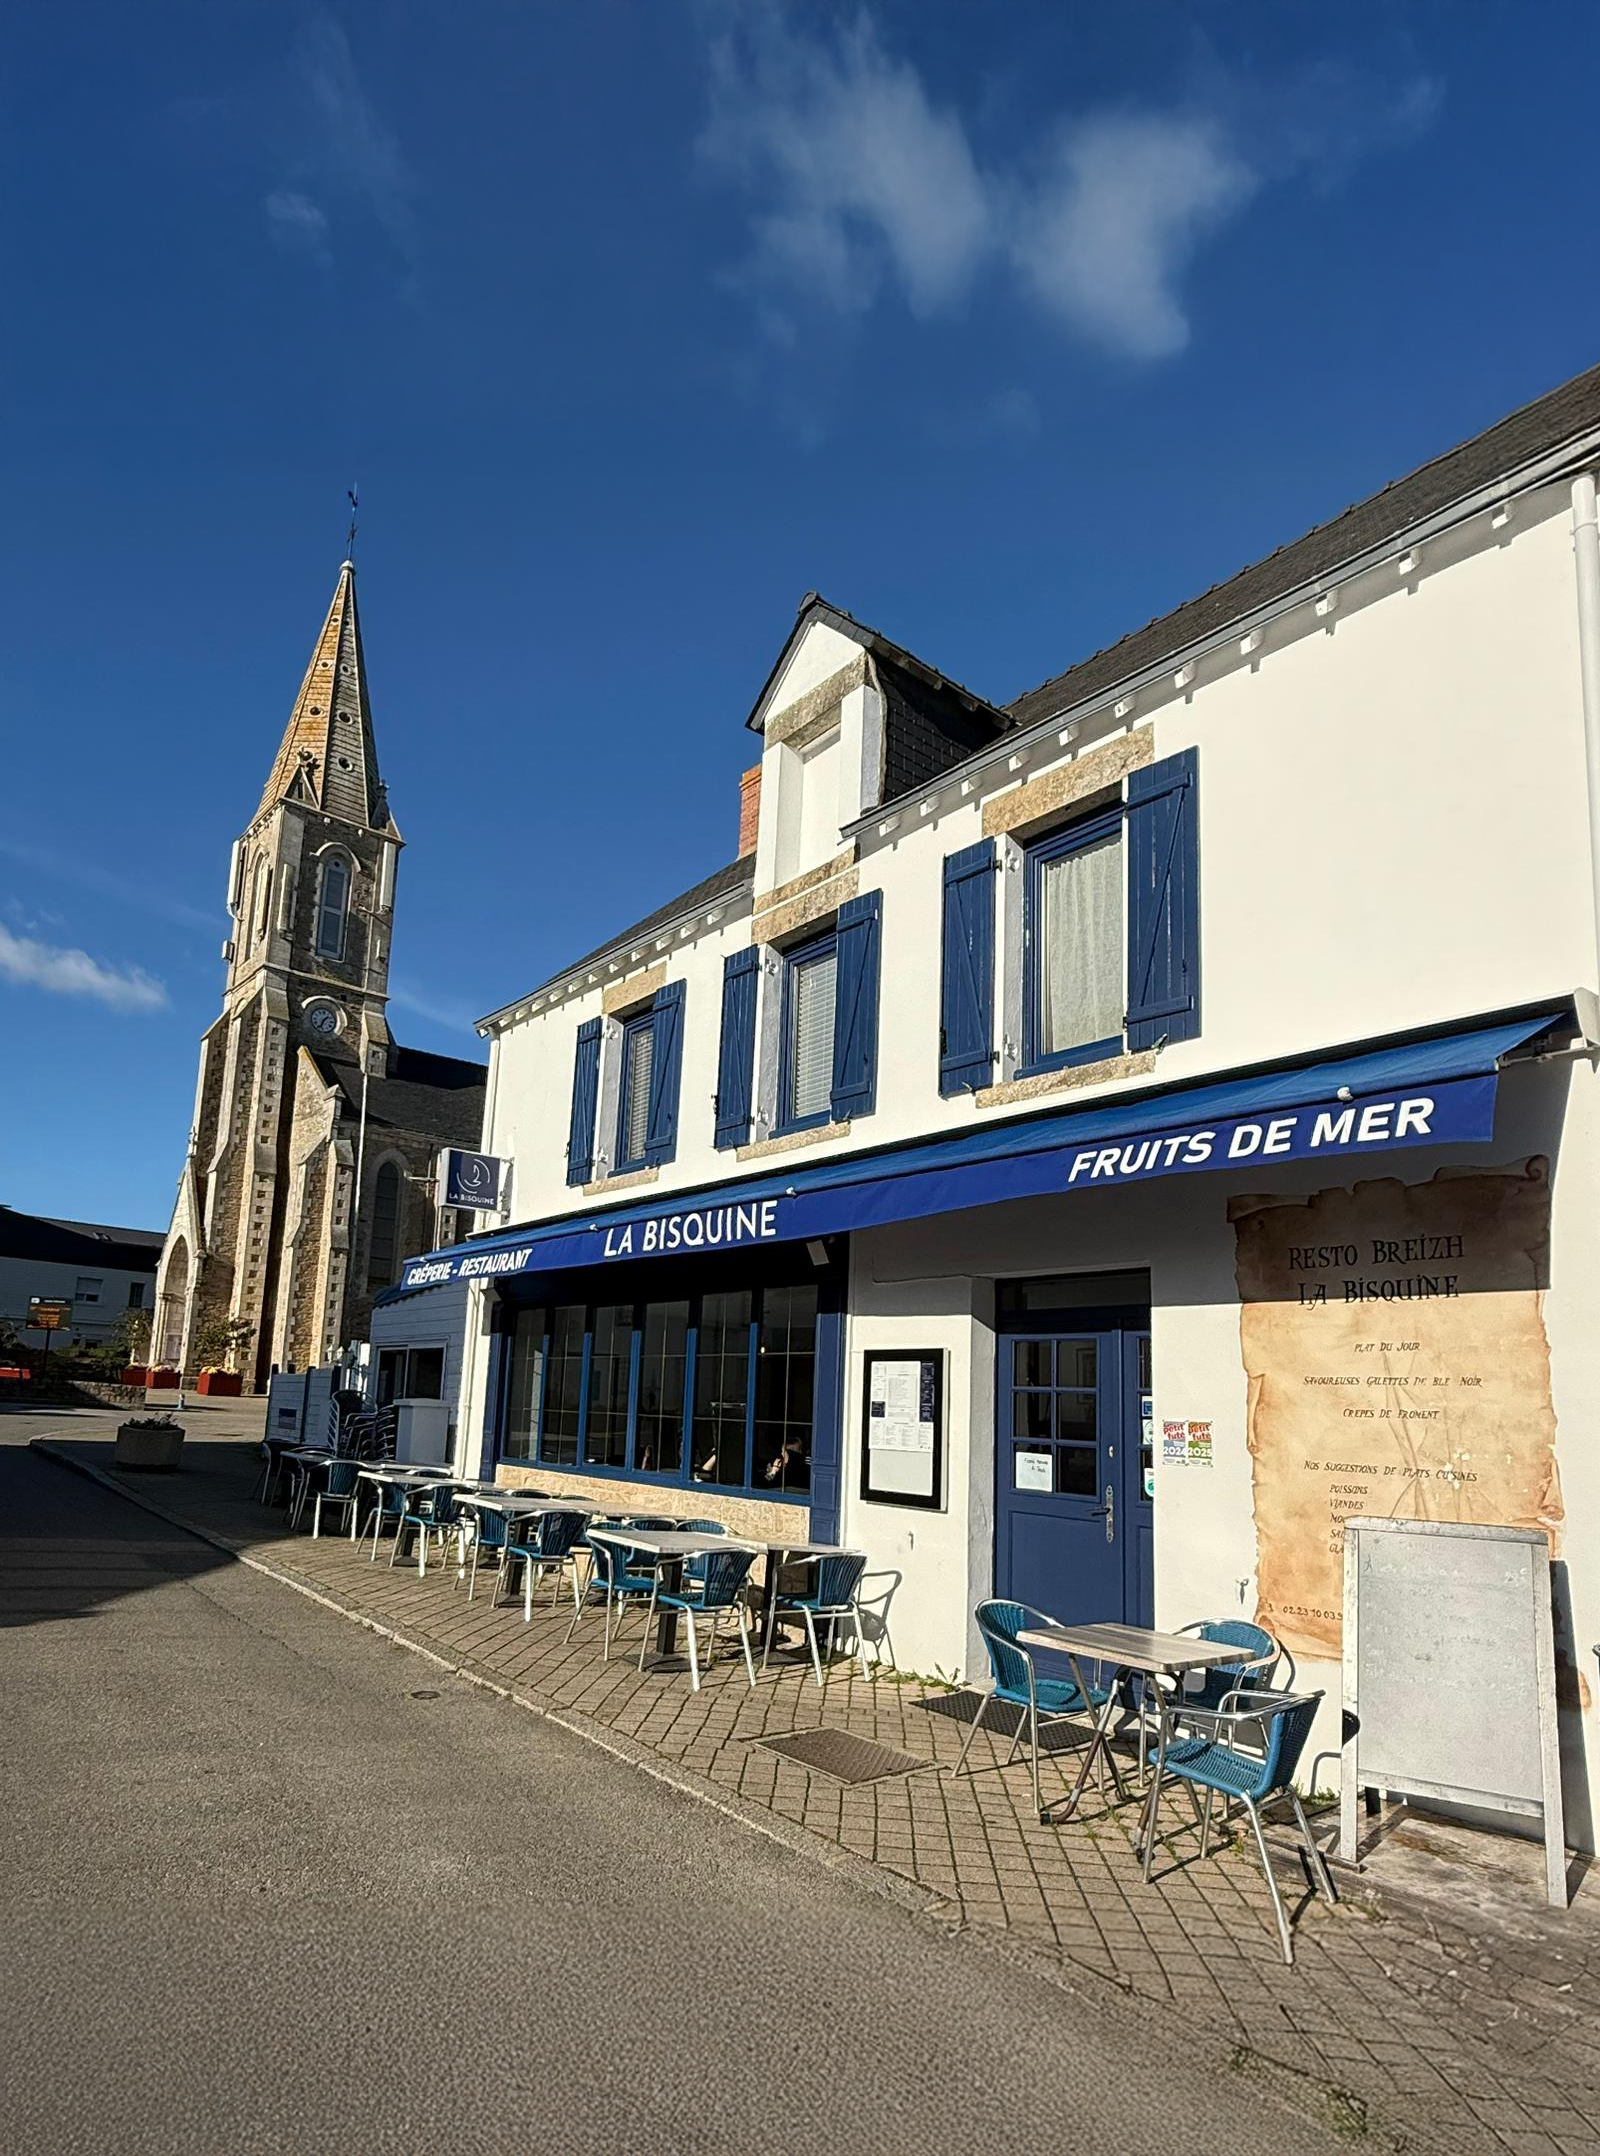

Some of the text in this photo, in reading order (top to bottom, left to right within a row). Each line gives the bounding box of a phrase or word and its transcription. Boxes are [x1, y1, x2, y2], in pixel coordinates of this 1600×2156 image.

[1068, 1097, 1435, 1182] FRUITS DE MER
[604, 1200, 778, 1257] LA BISQUINE
[1288, 1234, 1465, 1271] RESTO BREIZH
[458, 1248, 533, 1277] RESTAURANT
[1298, 1274, 1460, 1311] LA BISQUINE
[1354, 1341, 1421, 1353] PLAT DU JOUR
[1303, 1375, 1361, 1386] SAVOUREUSES
[1366, 1375, 1409, 1387] GALETTES
[1413, 1377, 1427, 1386] DE
[1459, 1375, 1483, 1388] NOIR
[1379, 1409, 1392, 1418] DE
[1398, 1409, 1440, 1420] FROMENT
[1163, 1446, 1187, 1455] 2024
[1188, 1447, 1212, 1457] 2025
[1304, 1460, 1320, 1471] NOS
[1324, 1461, 1378, 1475] SUGGESTIONS
[1383, 1466, 1397, 1476] DE
[1402, 1467, 1430, 1478] PLATS
[1329, 1484, 1368, 1495] POISSONS
[1329, 1499, 1365, 1510] VIANDES
